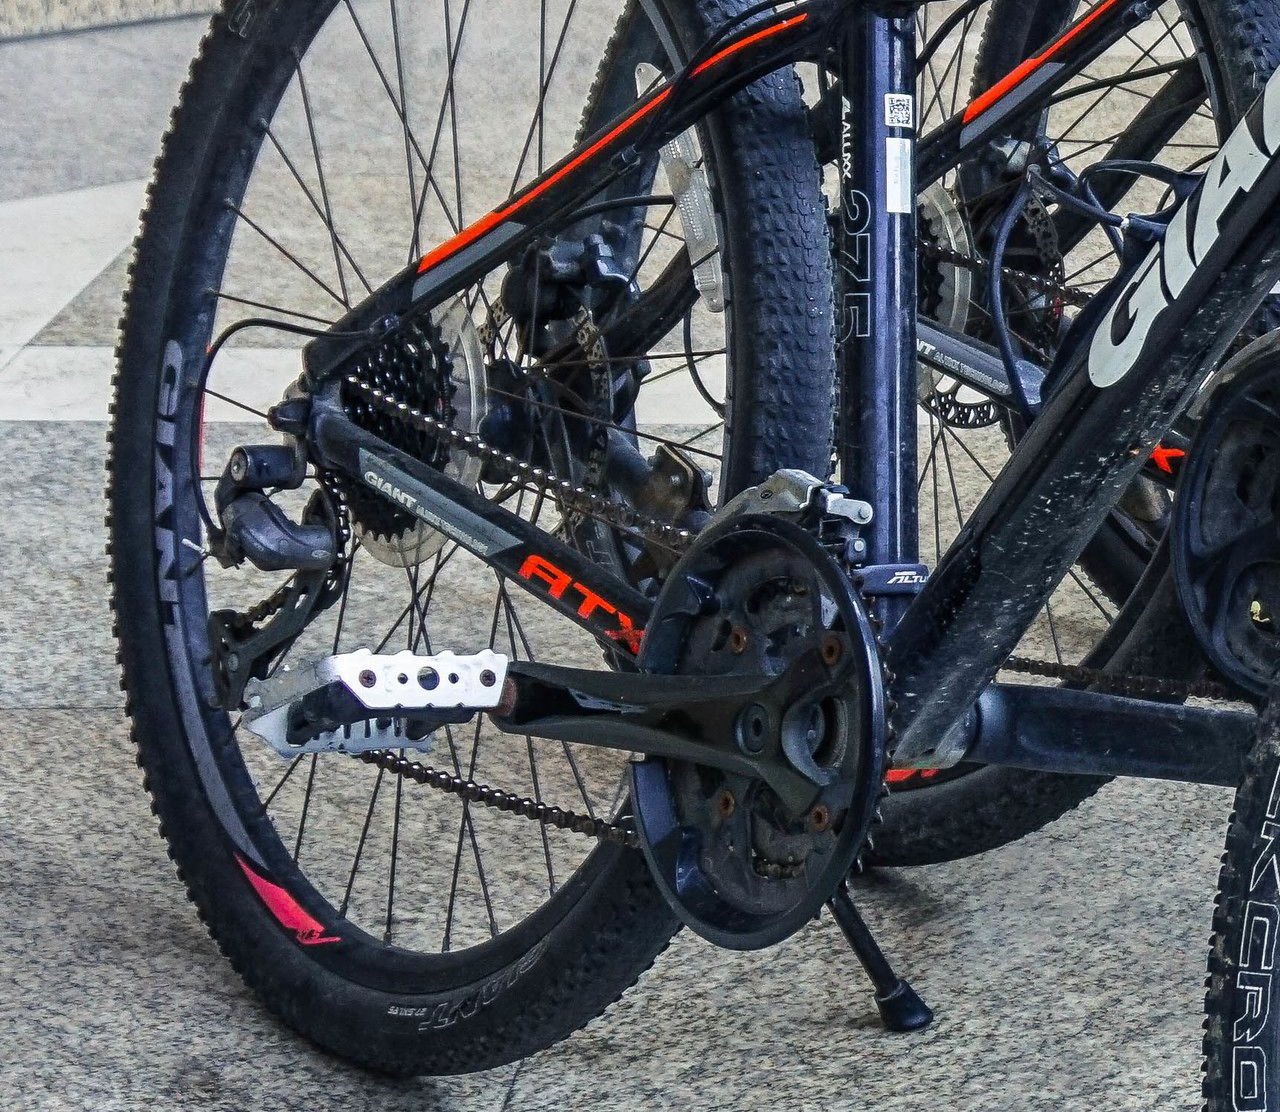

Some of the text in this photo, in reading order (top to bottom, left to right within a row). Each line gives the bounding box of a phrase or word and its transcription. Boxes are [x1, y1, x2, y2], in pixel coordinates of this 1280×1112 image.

[841, 119, 851, 180] ALUXX
[364, 470, 418, 509] GIANT
[518, 554, 645, 655] ATX
[886, 575, 929, 585] ALTU
